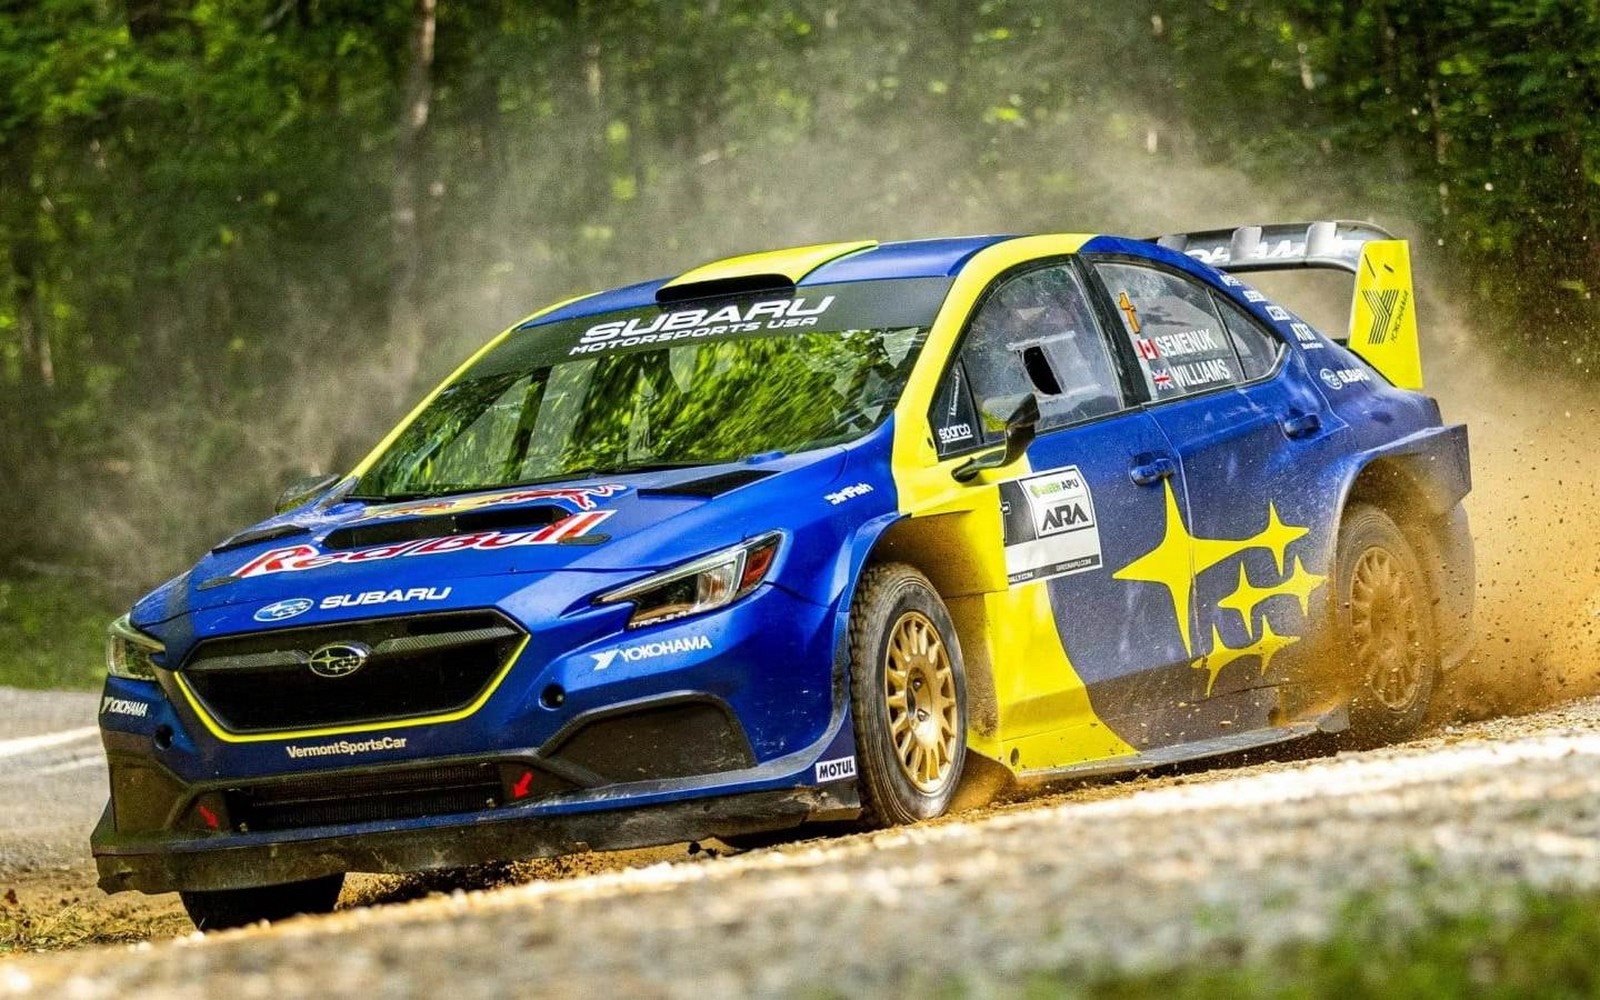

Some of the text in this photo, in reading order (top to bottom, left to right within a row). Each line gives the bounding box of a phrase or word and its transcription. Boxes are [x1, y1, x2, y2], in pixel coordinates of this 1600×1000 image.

[580, 296, 836, 343] SUBARU
[569, 317, 818, 355] MOTORSPORTS USA
[1155, 329, 1218, 357] SEMENUK
[1168, 359, 1231, 387] WILLIAMS
[1061, 478, 1080, 491] APU
[1042, 502, 1089, 531] ARA
[230, 509, 617, 578] Red Bull
[320, 587, 452, 610] SUBARU
[620, 635, 713, 663] YOKOHAMA
[286, 736, 407, 759] VermontSportsCar
[819, 760, 854, 779] MOTUL
